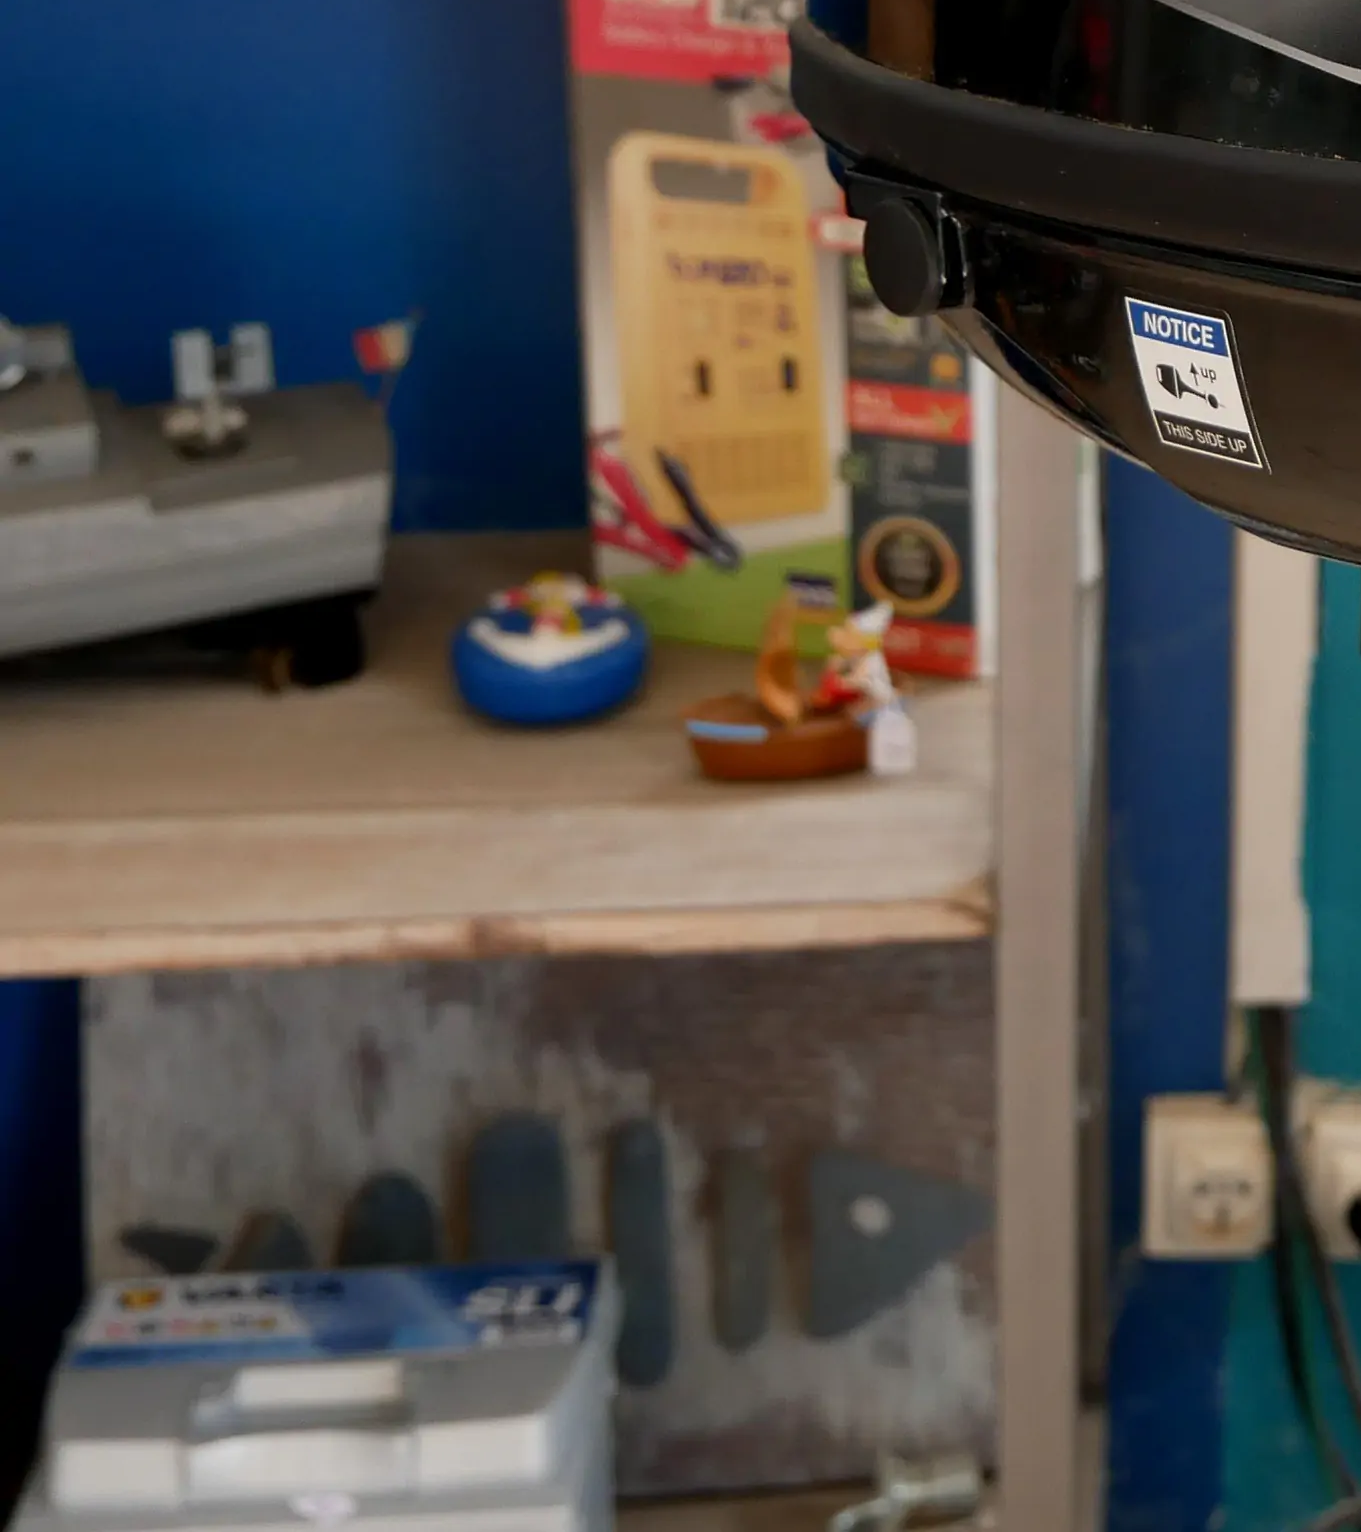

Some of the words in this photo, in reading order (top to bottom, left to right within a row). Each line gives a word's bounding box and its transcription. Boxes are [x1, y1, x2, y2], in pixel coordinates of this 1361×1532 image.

[1143, 311, 1214, 348] NOTICE
[1200, 367, 1217, 383] up
[1162, 419, 1194, 441] THIS
[1195, 429, 1227, 449] SIDE
[1228, 438, 1247, 453] UP
